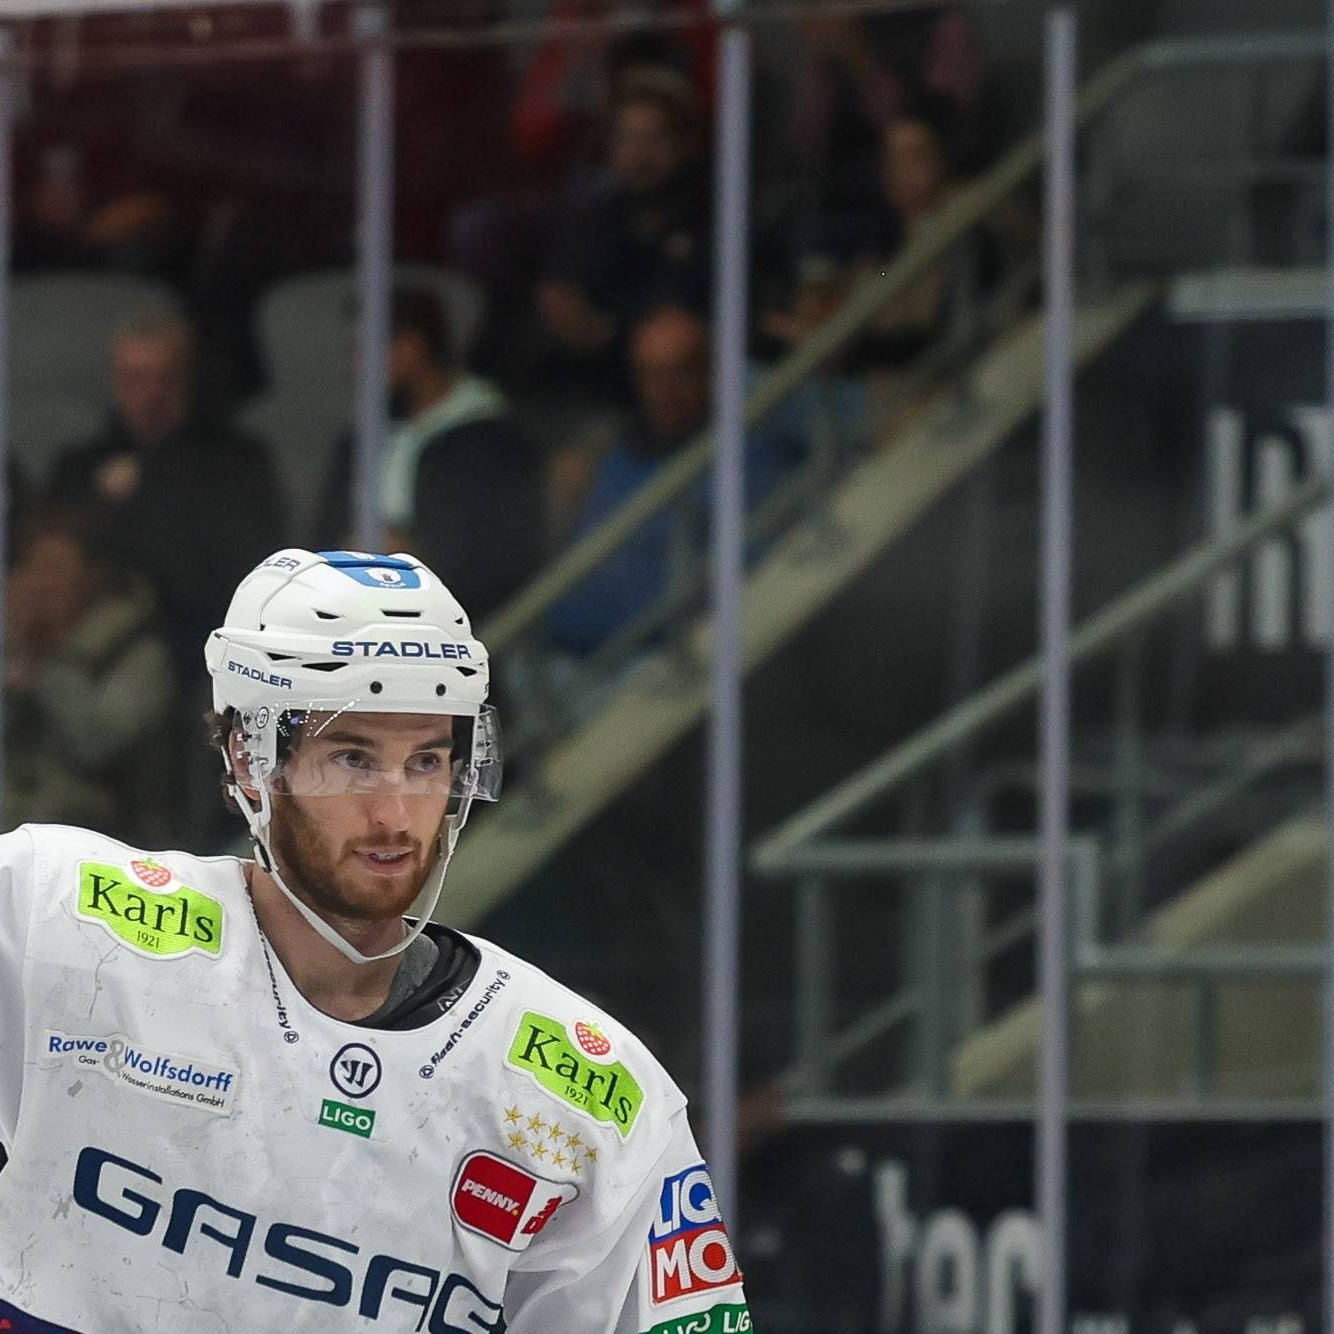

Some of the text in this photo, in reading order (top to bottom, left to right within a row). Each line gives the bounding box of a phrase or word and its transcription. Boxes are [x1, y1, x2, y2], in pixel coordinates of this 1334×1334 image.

[331, 640, 472, 660] STADLER
[227, 660, 293, 690] STADLER
[87, 873, 215, 944] Karls
[135, 930, 161, 949] 1921
[430, 978, 506, 1066] flash-security
[49, 1036, 108, 1053] Rawe
[124, 1046, 233, 1093] Wolfsdorff
[518, 1025, 634, 1126] Karls
[121, 1072, 195, 1101] Wasserinstallations
[196, 1093, 225, 1109] GmbH
[563, 1084, 588, 1106] 1921
[322, 1105, 372, 1131] LIGO
[654, 1169, 720, 1236] LIQ
[655, 1229, 743, 1291] MO
